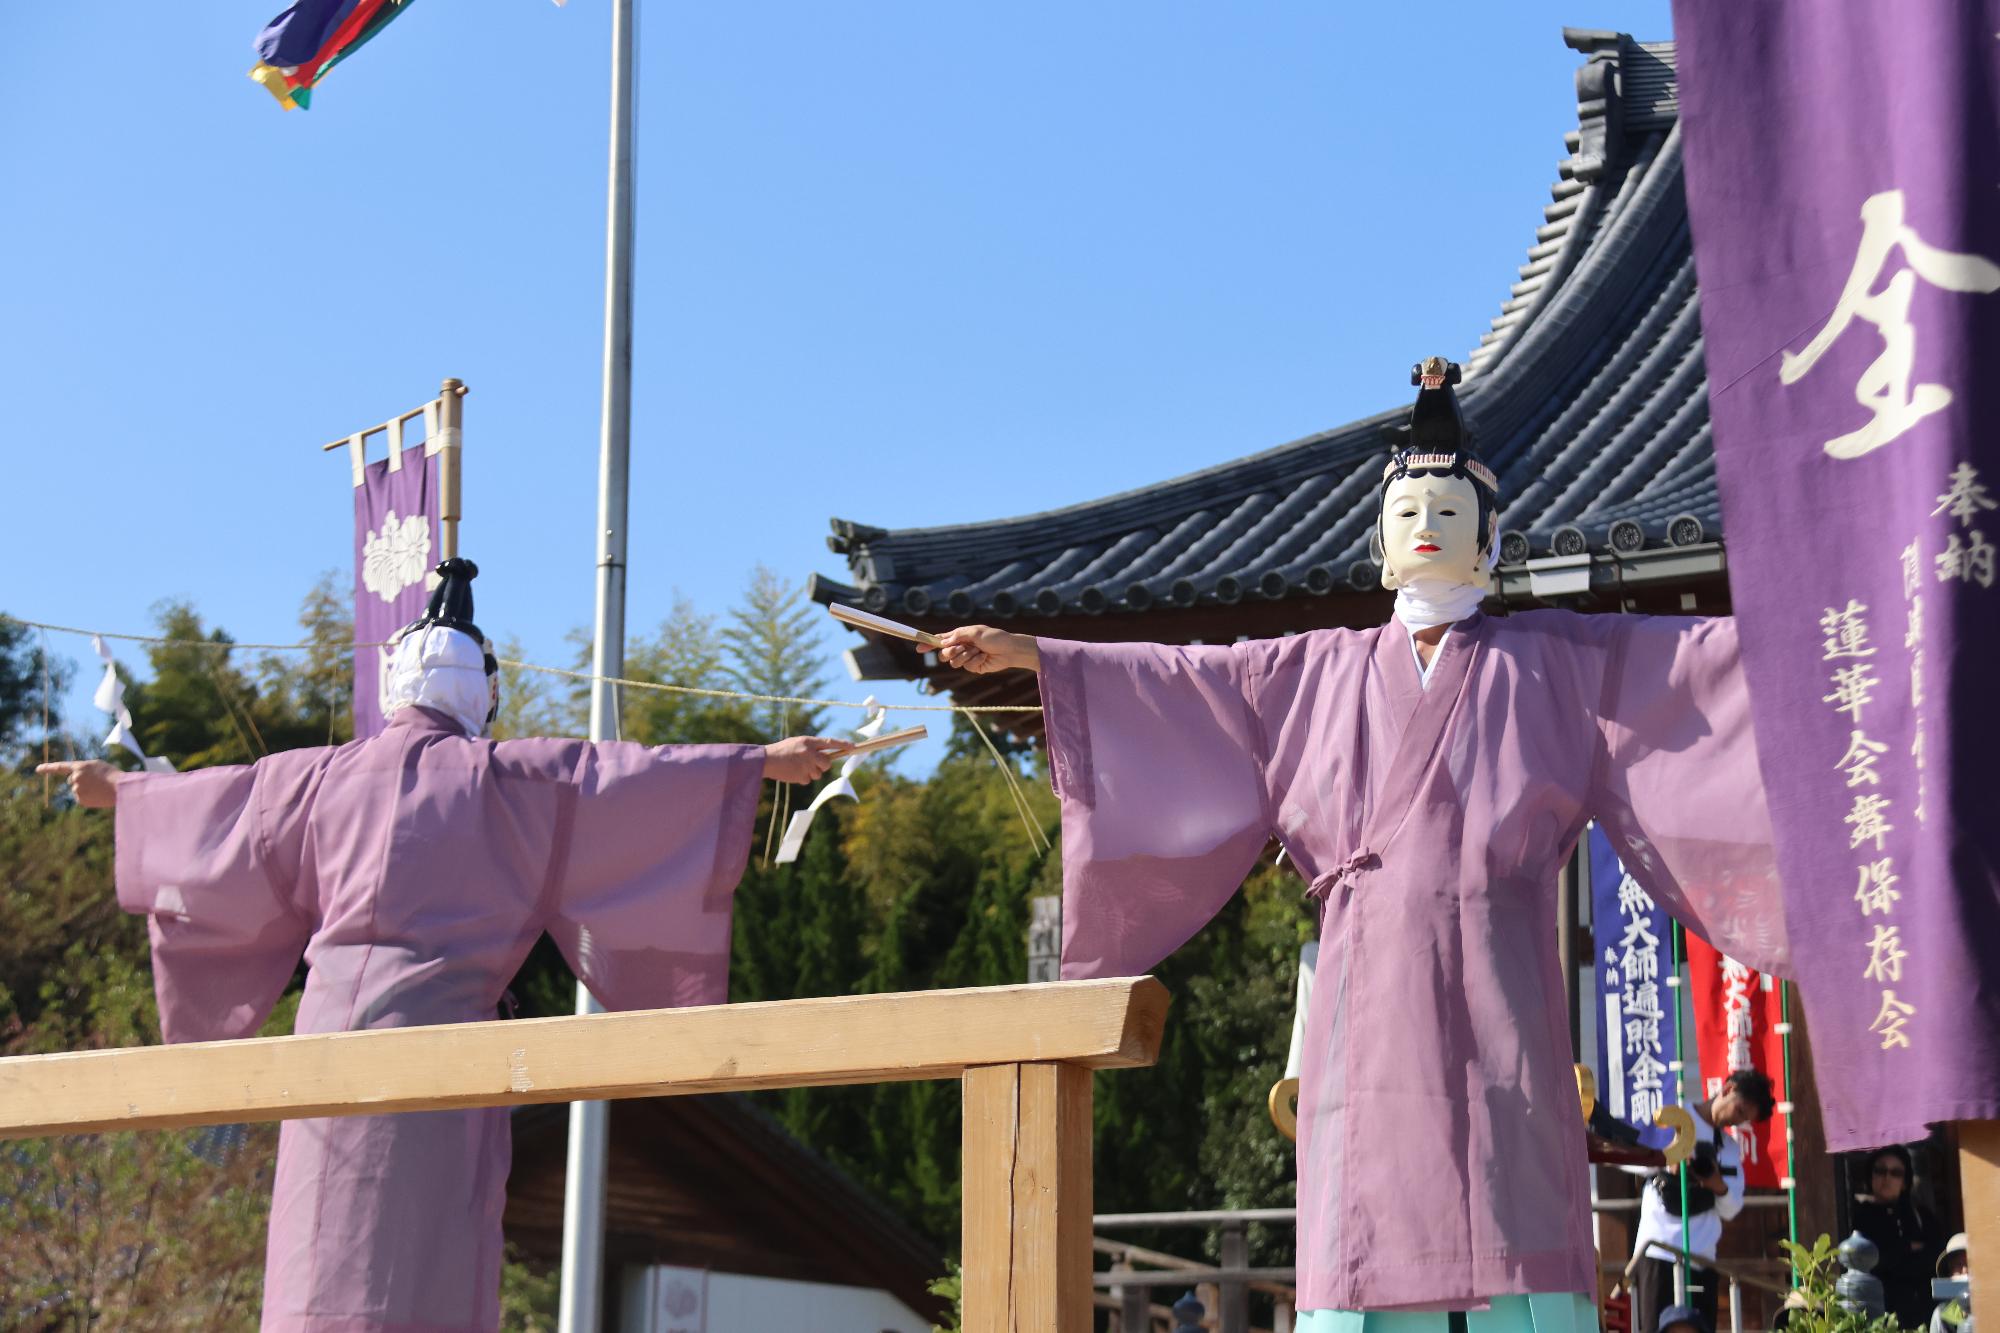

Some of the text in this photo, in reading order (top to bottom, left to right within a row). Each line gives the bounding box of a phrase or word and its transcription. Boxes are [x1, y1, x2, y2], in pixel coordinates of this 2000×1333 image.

[1930, 462, 1997, 588] 奉納
[1820, 598, 1916, 1050] 蓮華会舞保存会
[1618, 857, 1667, 1126] 無大師遍照金剛
